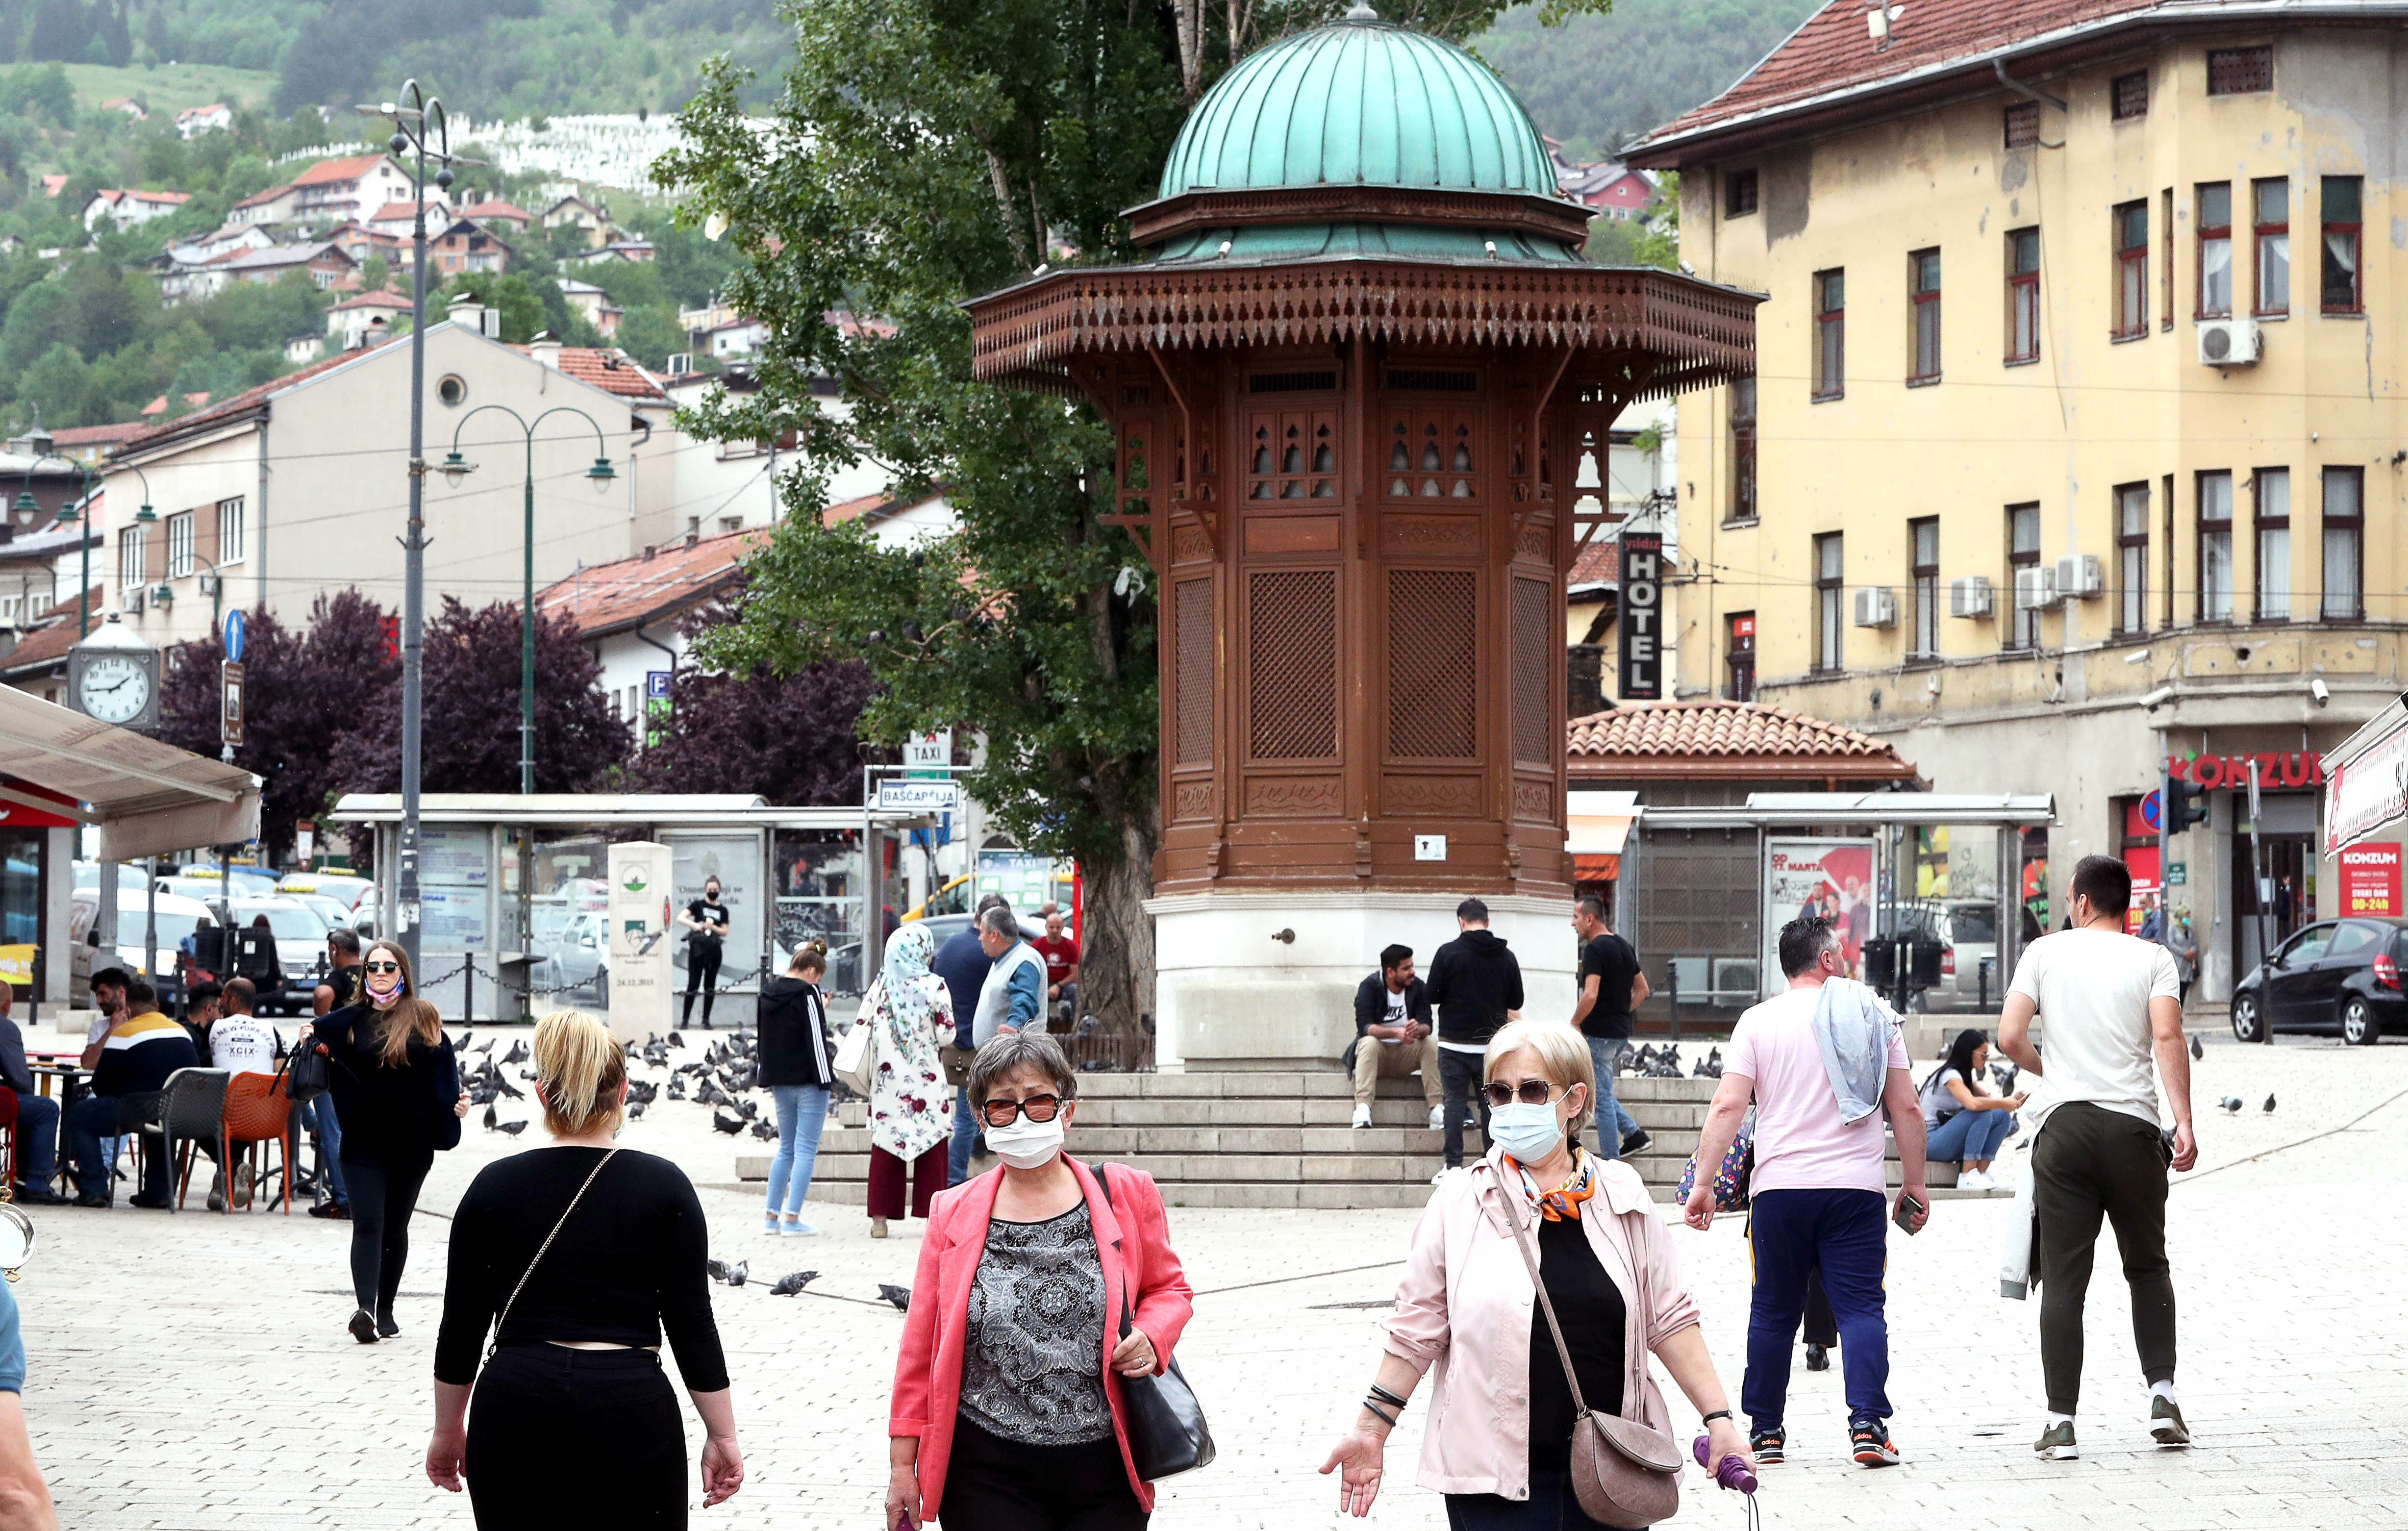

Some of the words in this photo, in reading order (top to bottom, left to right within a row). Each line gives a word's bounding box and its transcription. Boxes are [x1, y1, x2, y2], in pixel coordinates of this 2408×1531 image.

[1628, 554, 1656, 688] HOTEL
[914, 747, 941, 760] TAXI
[2167, 752, 2324, 789] KONZU
[1009, 858, 1037, 868] TAXI
[2343, 852, 2397, 864] KONZUM
[1788, 863, 1823, 871] MARTA
[2351, 898, 2389, 911] 00-24h
[1853, 1433, 1872, 1441] adidas
